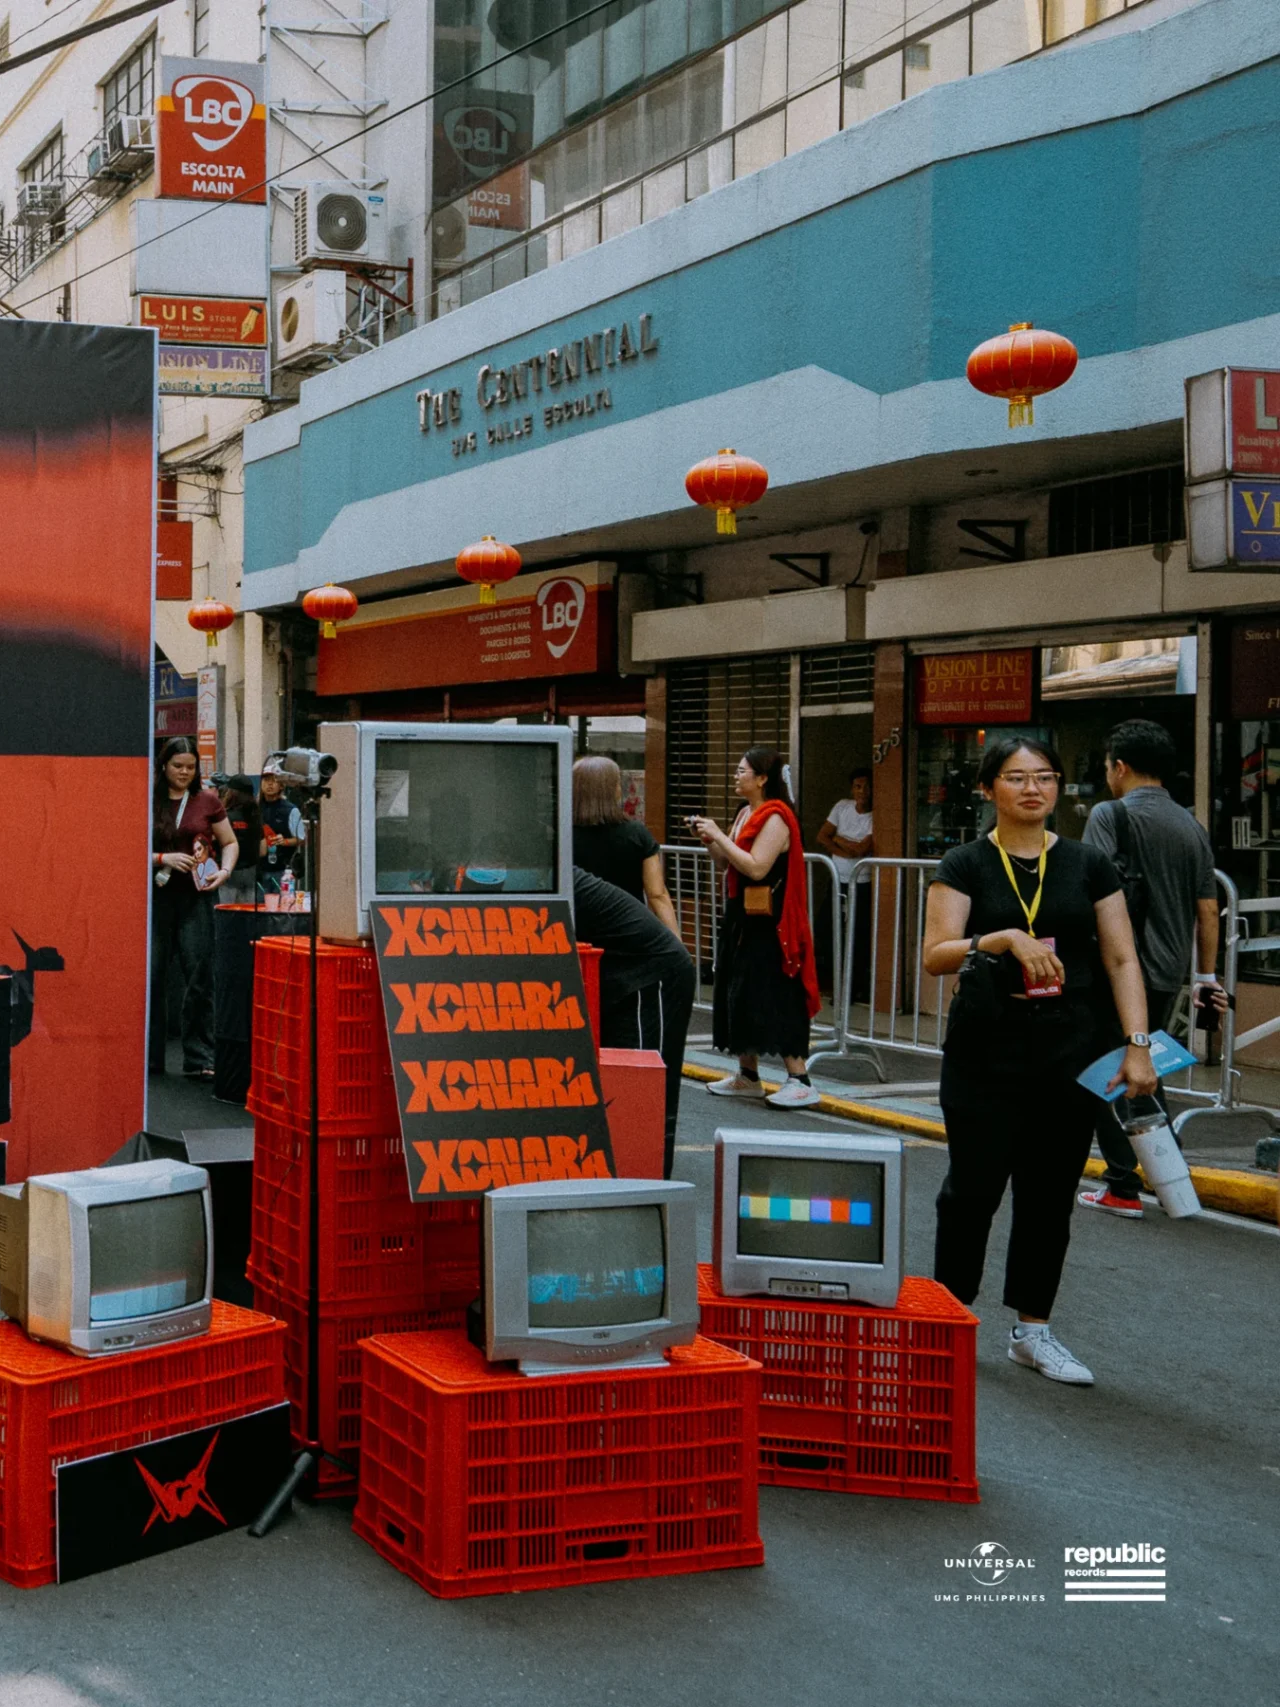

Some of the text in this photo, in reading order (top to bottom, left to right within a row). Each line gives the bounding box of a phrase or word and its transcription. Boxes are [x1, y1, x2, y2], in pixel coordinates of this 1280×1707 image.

[184, 97, 242, 127] LBC
[181, 162, 246, 179] ESCOLTA
[192, 180, 234, 194] MAIN
[144, 301, 205, 321] LUIS
[159, 352, 209, 369] ISION
[416, 313, 661, 430] THE CENTENNIAL
[487, 414, 533, 445] CALLE
[543, 388, 612, 426] ESCOLTA
[157, 560, 183, 568] EXPRESS
[542, 599, 578, 631] LBC
[924, 652, 1025, 677] VISION LINE
[928, 678, 1021, 693] OPTICAL
